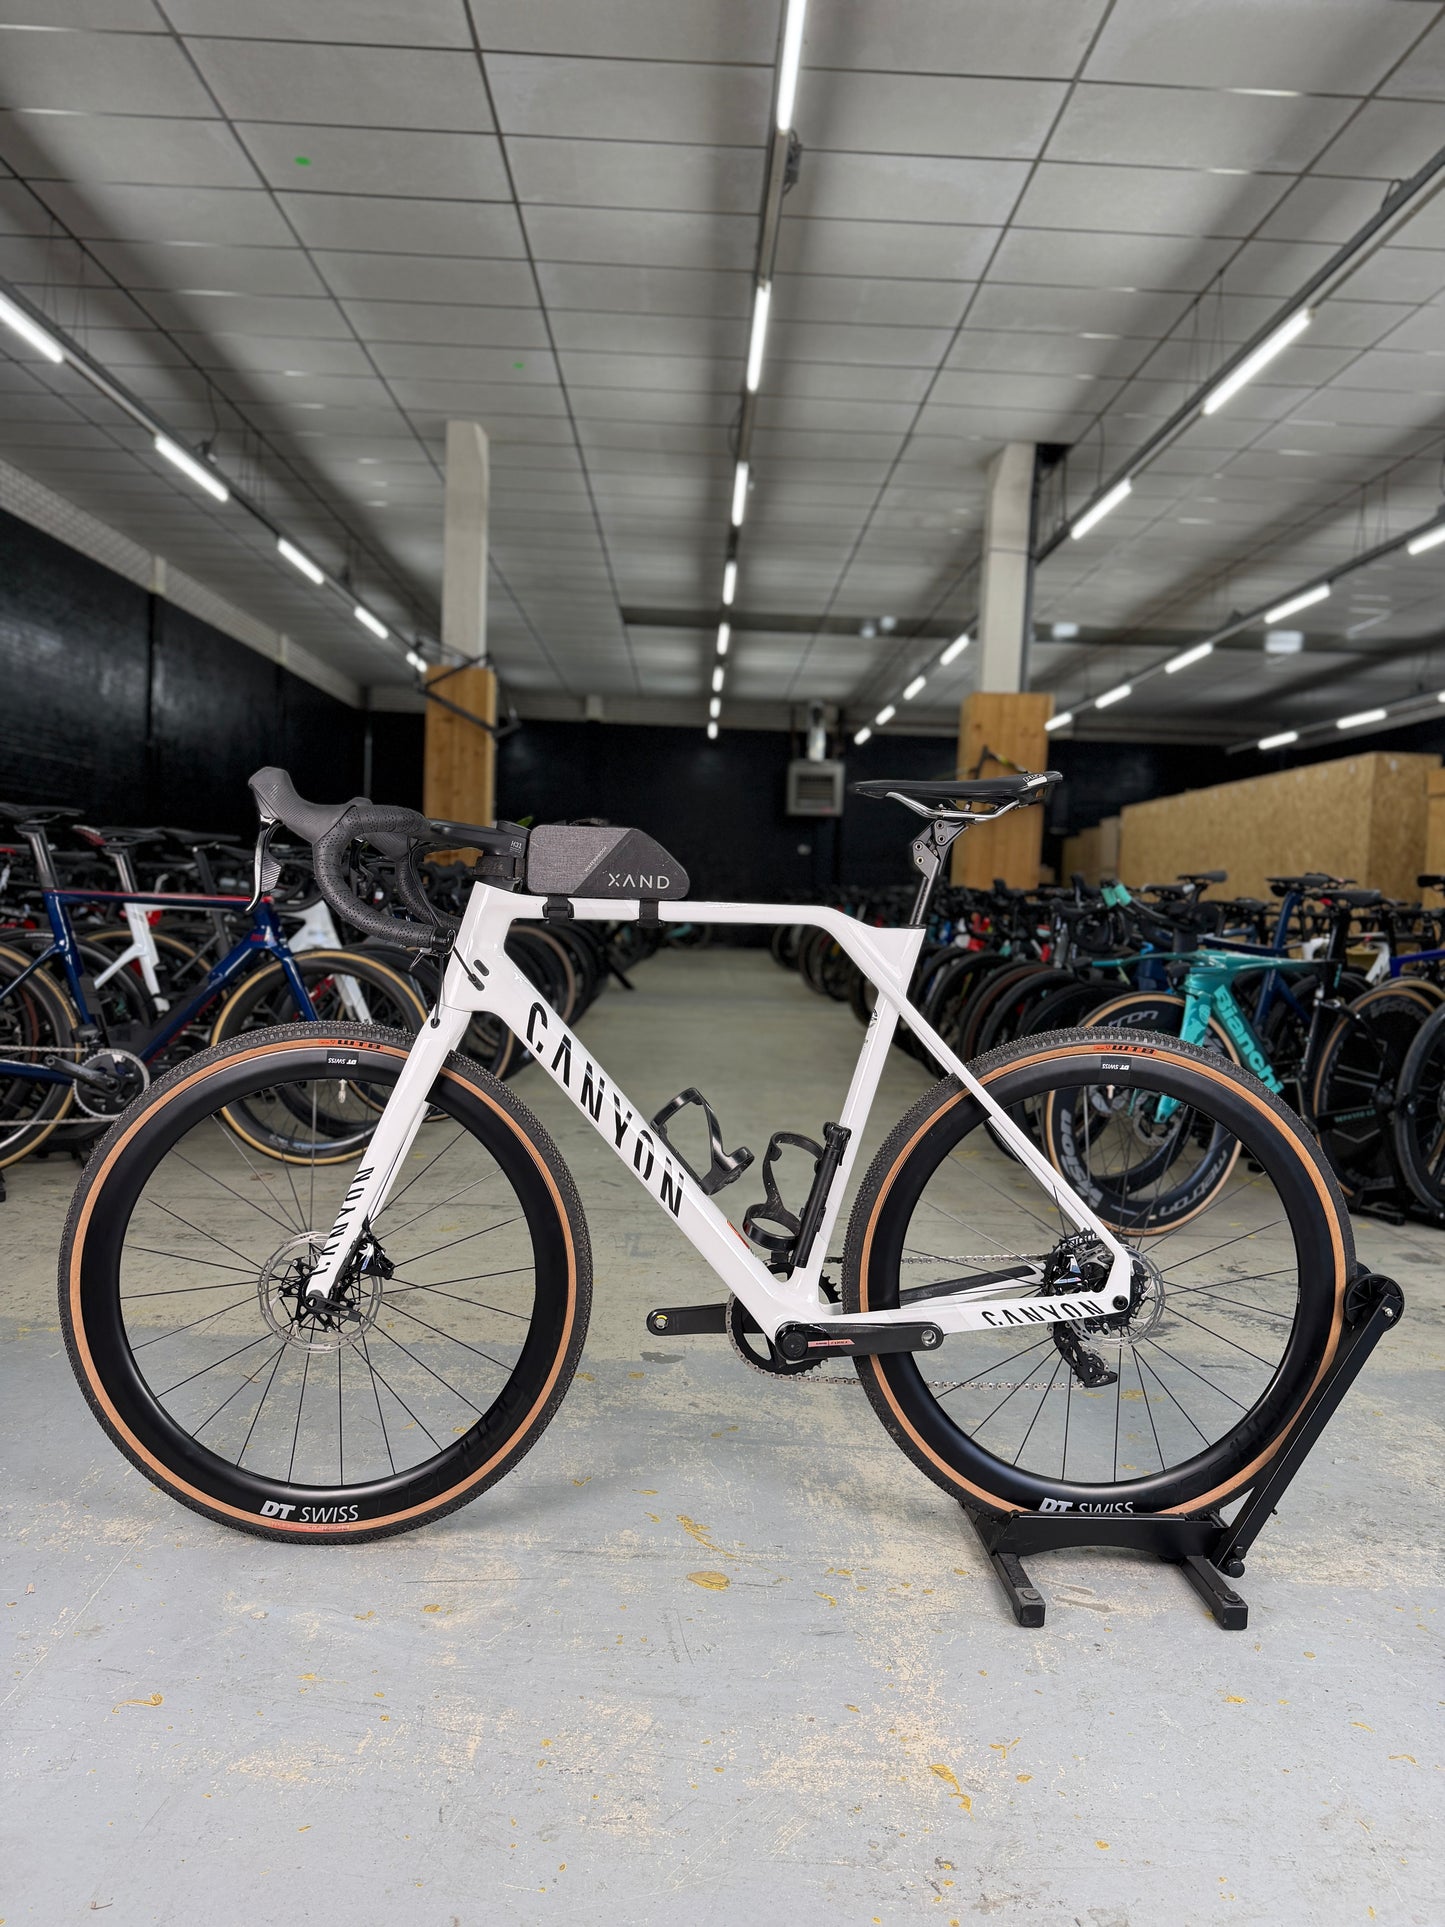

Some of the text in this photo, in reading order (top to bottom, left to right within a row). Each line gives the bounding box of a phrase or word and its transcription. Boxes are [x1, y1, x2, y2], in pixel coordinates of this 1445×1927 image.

[608, 873, 670, 889] XAND
[328, 1057, 346, 1065] SWISS
[526, 1001, 685, 1218] CANYON
[310, 1166, 375, 1276] CANYON
[981, 1299, 1105, 1327] CANYON
[259, 1500, 359, 1523] DT SWISS
[1038, 1497, 1073, 1513] DT
